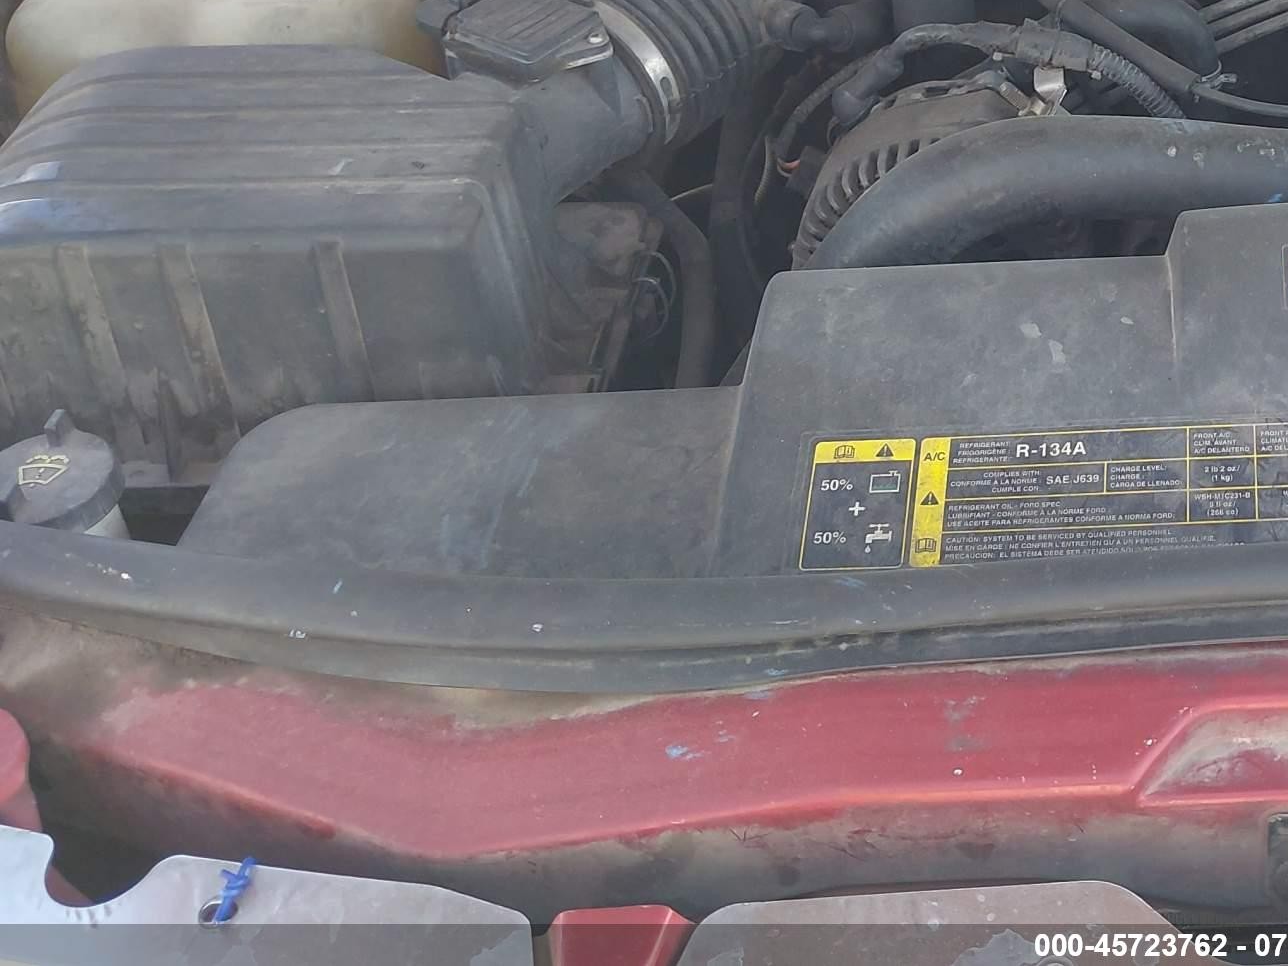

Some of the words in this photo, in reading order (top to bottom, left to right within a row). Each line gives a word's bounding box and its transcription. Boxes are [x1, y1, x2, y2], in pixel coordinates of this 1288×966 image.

[1015, 441, 1087, 458] R-134A
[923, 450, 946, 462] A/C
[820, 478, 854, 492] 50%
[1046, 475, 1070, 485] SAE
[1073, 474, 1100, 484] J639
[948, 504, 1000, 512] REFRIGERANT
[992, 518, 1011, 526] PARA
[1075, 514, 1116, 522] CONFORME
[813, 530, 847, 545] 50%
[1038, 532, 1074, 540] SERVICED
[1088, 530, 1126, 538] QUALIFIED
